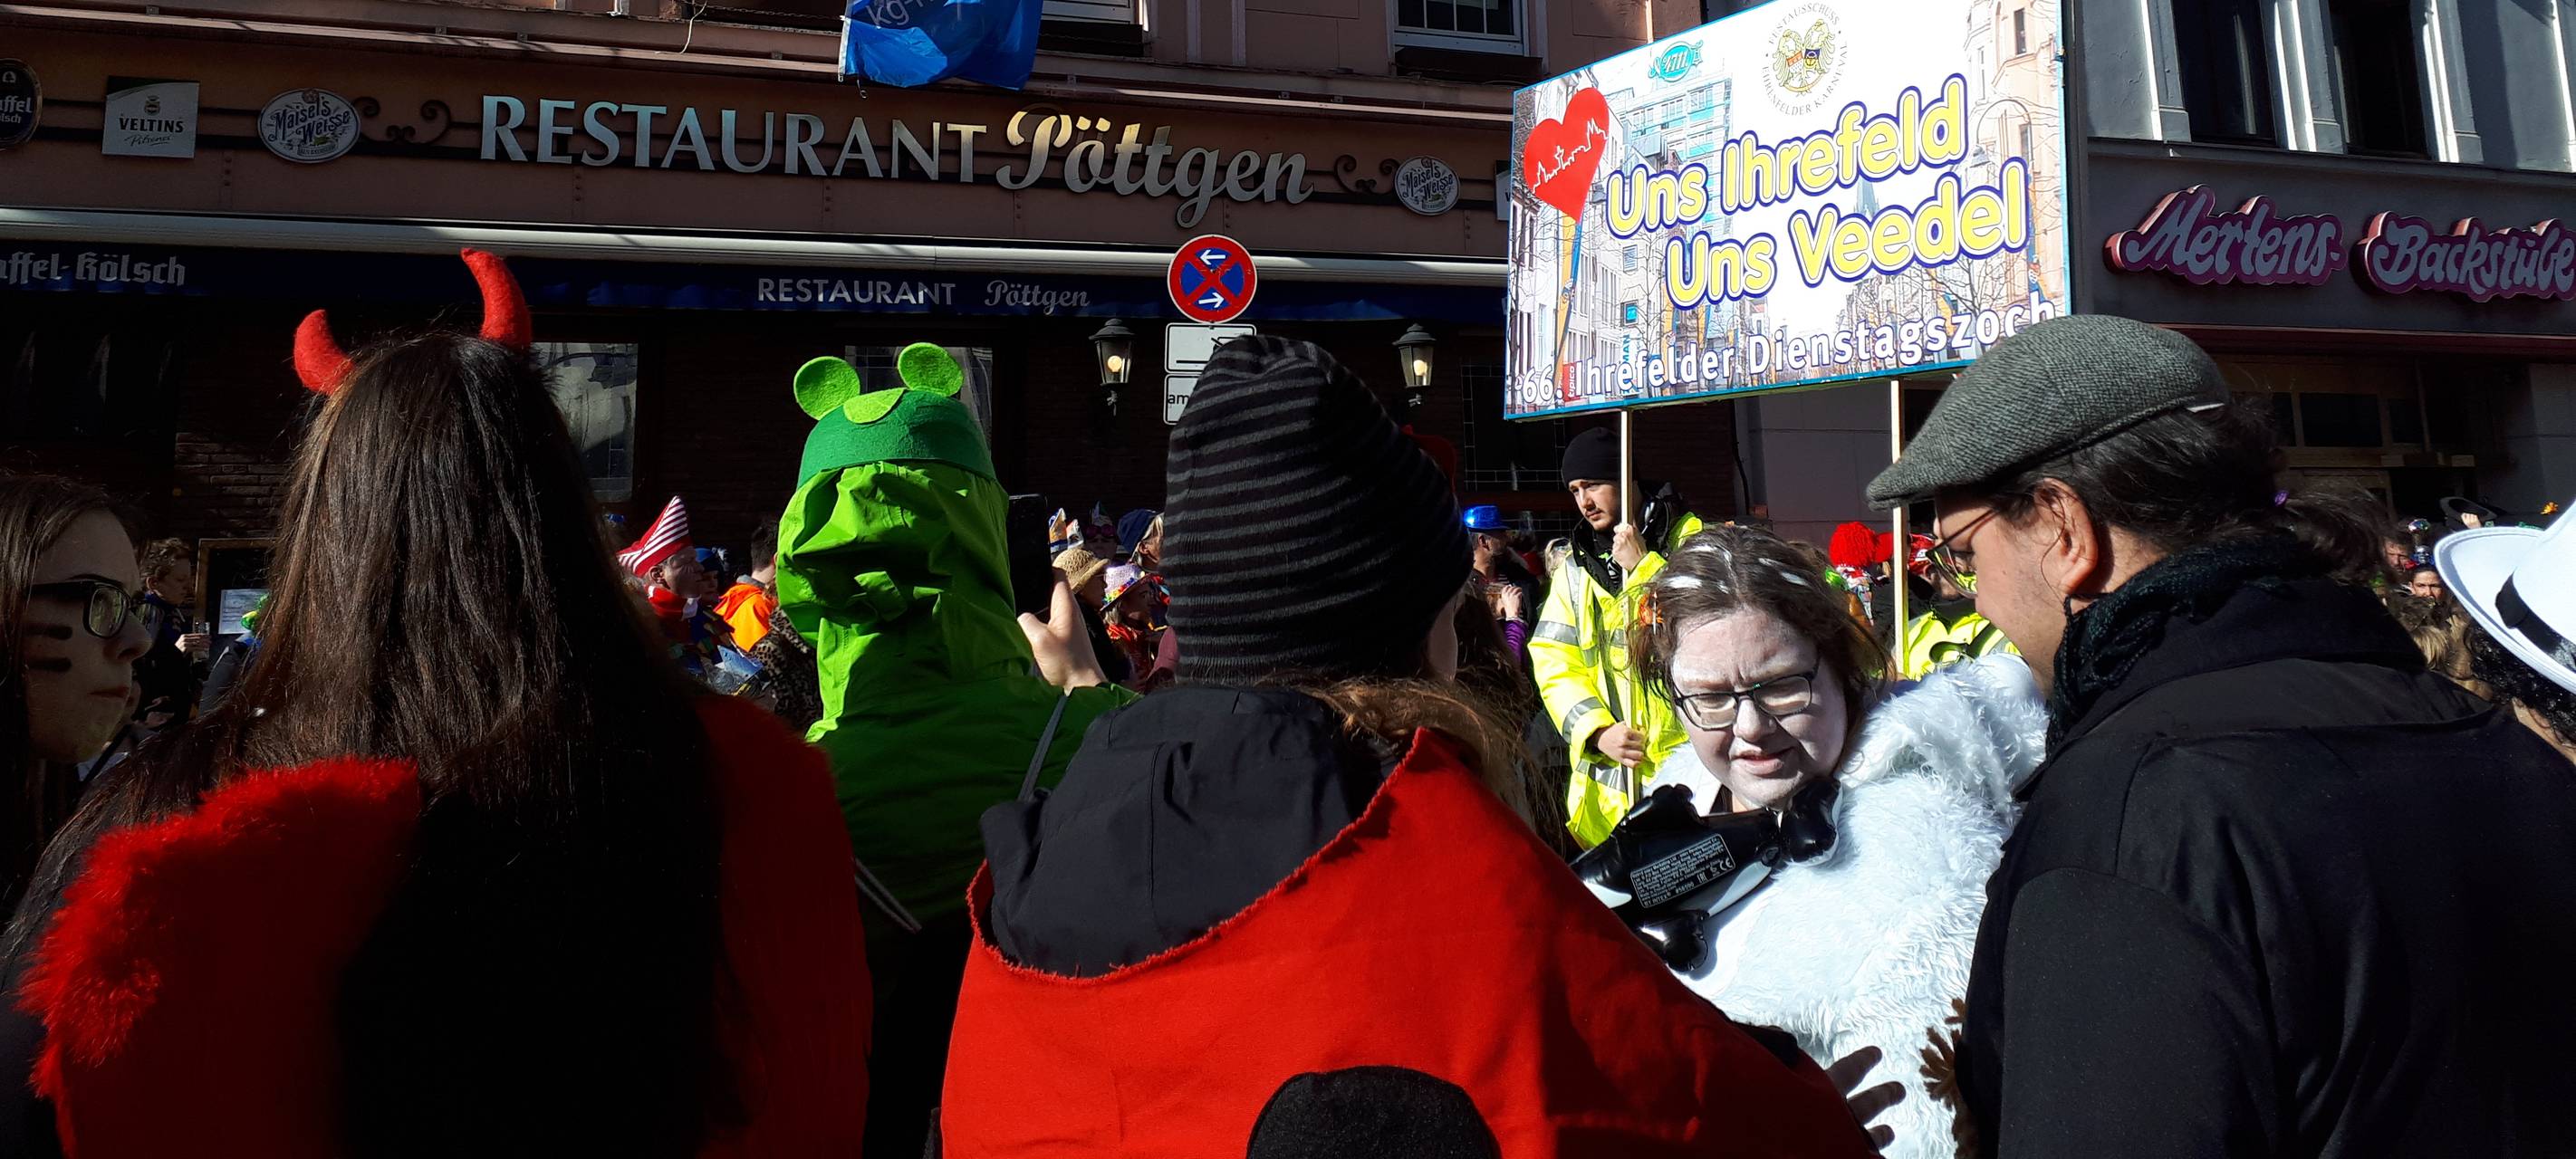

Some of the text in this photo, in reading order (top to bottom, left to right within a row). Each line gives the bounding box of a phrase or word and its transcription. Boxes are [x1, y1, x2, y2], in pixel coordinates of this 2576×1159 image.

[1762, 41, 1848, 117] EHRENFELDER KARNEVAL
[119, 117, 184, 134] VELTINS
[295, 110, 351, 145] Weisse
[479, 93, 1316, 229] RESTAURANT Pöttgen
[1606, 72, 1969, 239] Uns Ihrefeld
[1419, 173, 1454, 200] Weisse
[1665, 157, 2032, 311] Uns Veedel
[2124, 190, 2341, 278] Mertens
[757, 277, 1091, 316] RESTAURANT Pöttgen
[1575, 341, 1737, 398] Ihrefelder
[1747, 290, 2056, 376] Dienstagszoch
